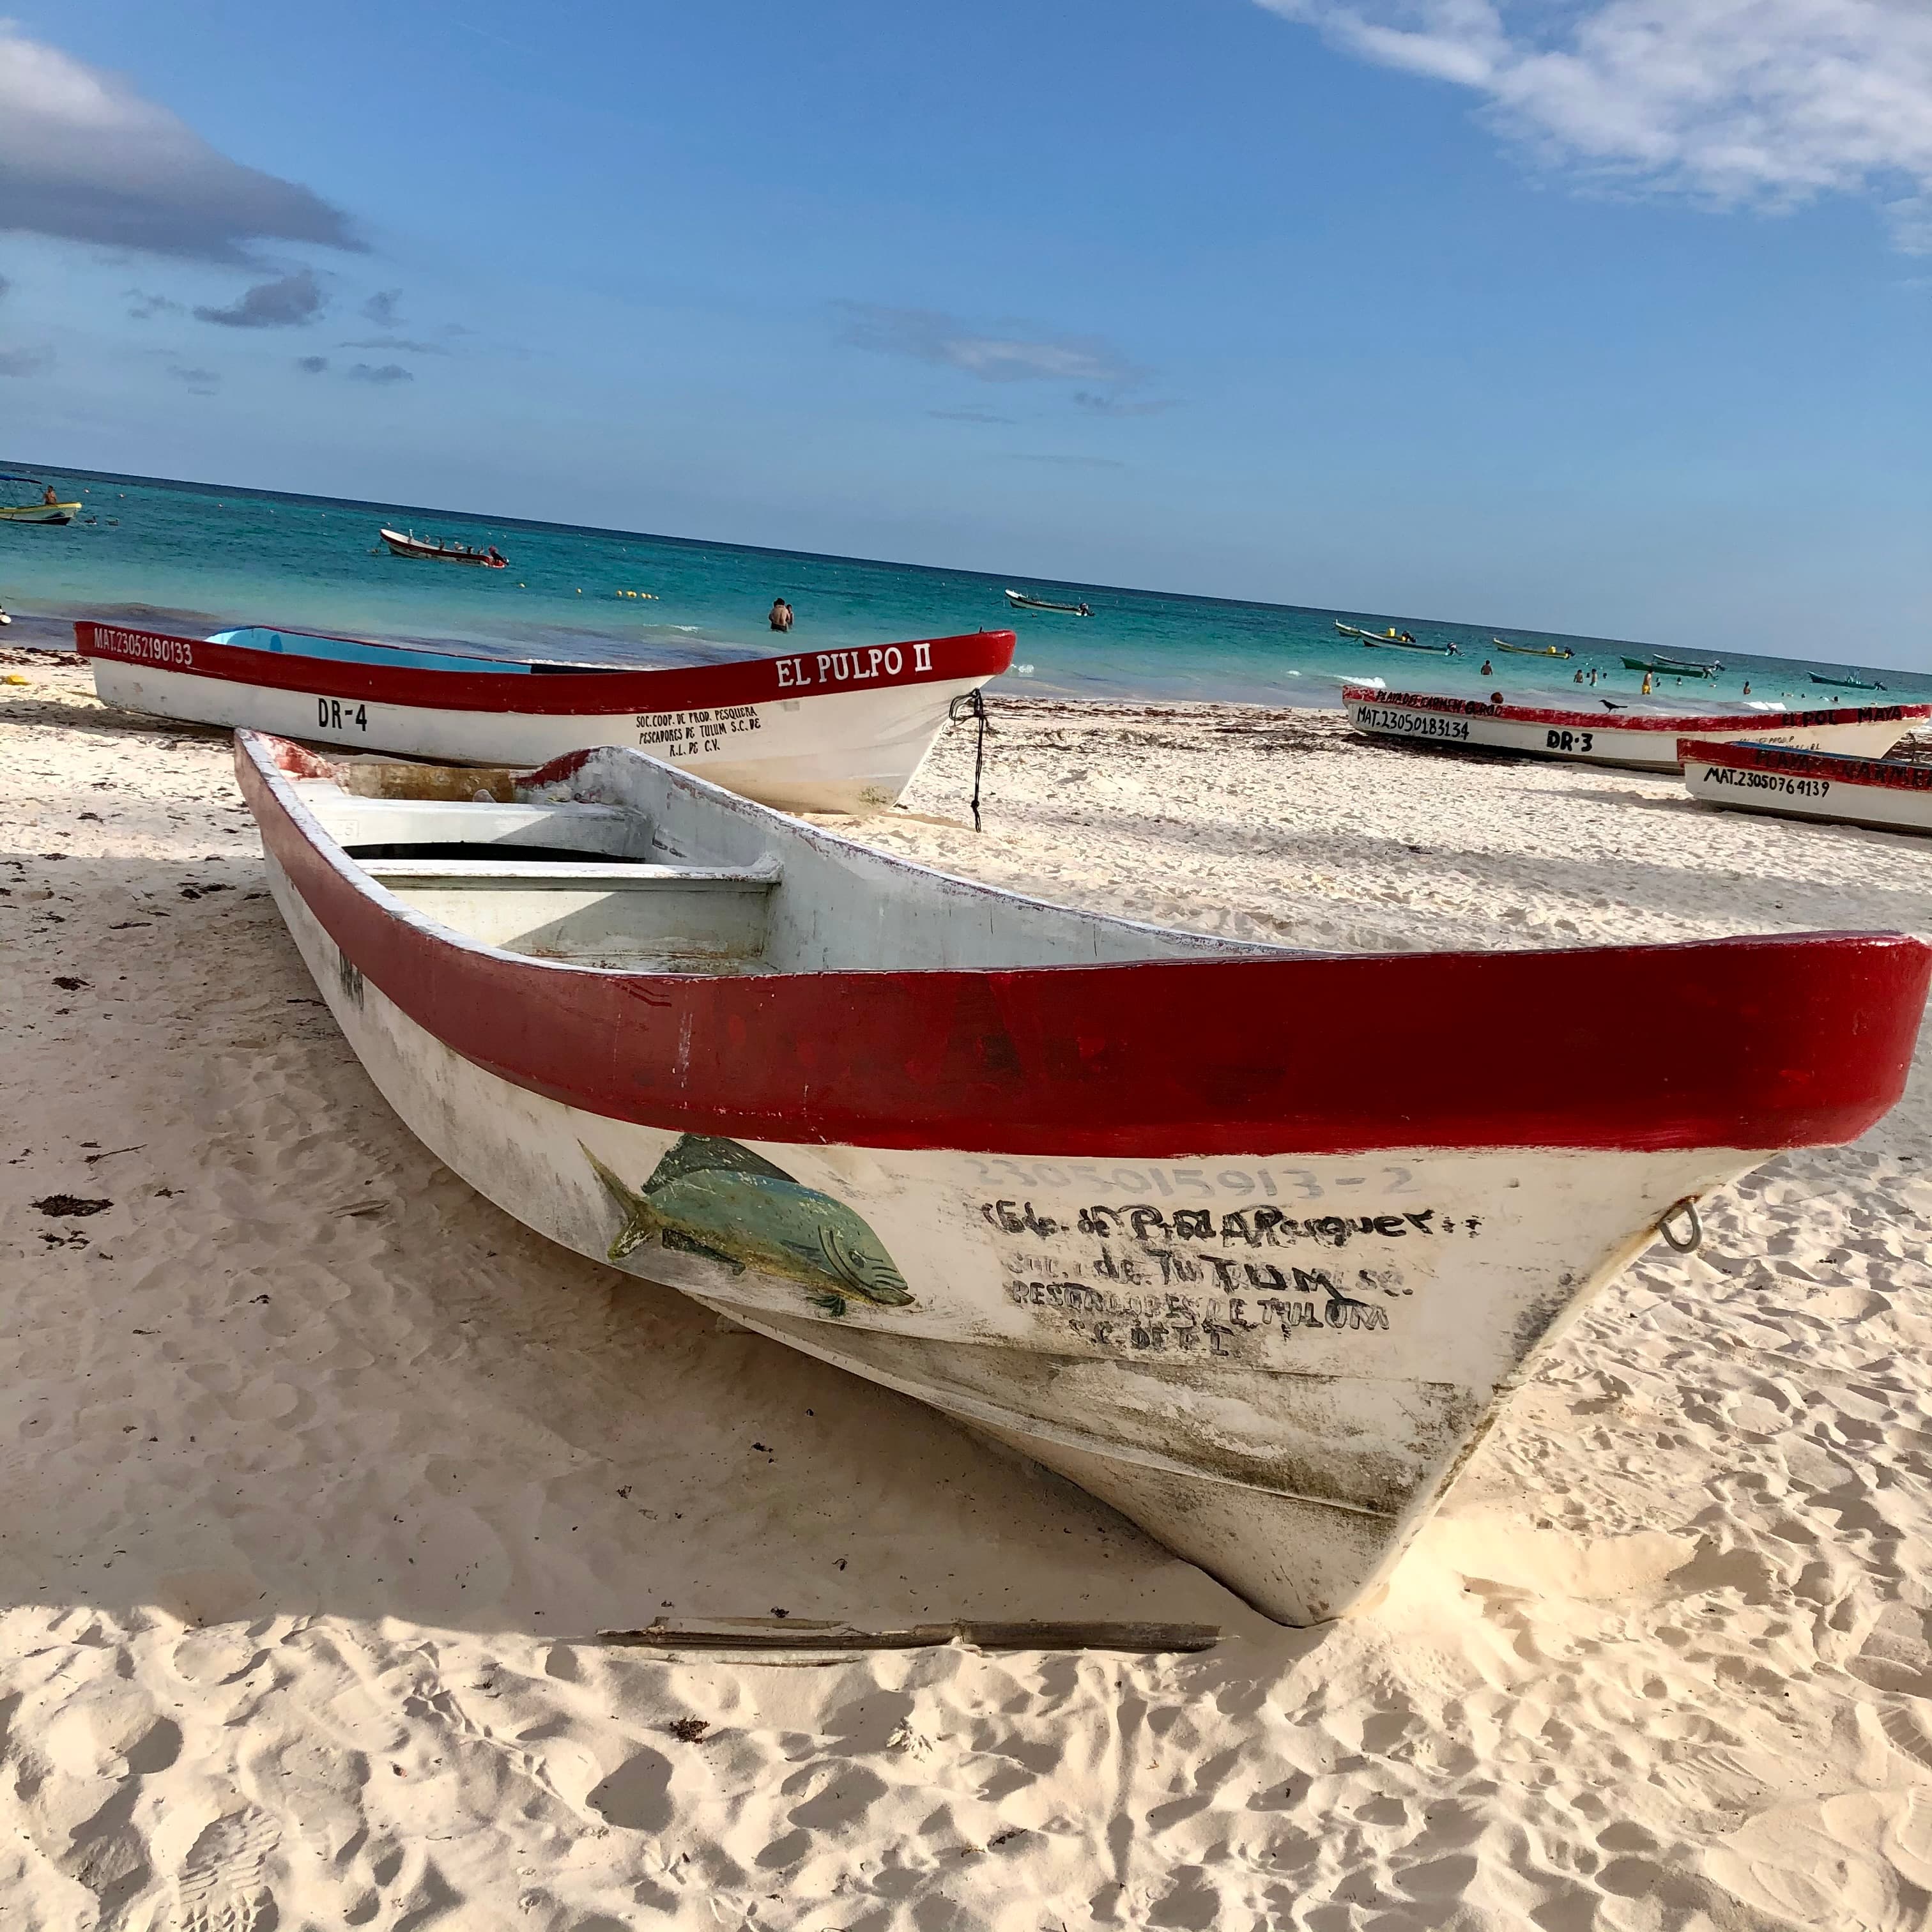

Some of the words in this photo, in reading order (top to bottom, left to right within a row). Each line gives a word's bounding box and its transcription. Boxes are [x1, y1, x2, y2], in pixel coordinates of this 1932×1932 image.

[95, 627, 192, 665] MAT.23052190133
[776, 658, 811, 687] EL
[816, 647, 903, 683] PULPO
[913, 643, 933, 672] II
[318, 698, 367, 732] DR-4
[639, 728, 683, 745] PESCADORES
[686, 727, 695, 739] DE
[700, 723, 727, 738] TULUM
[749, 718, 761, 730] DE
[689, 711, 712, 723] PROD.
[714, 706, 758, 721] PESQUERA
[1358, 706, 1469, 740] MAT.23050183134
[670, 744, 686, 757] R.L.
[689, 742, 698, 755] DE
[704, 739, 721, 752] C.V.
